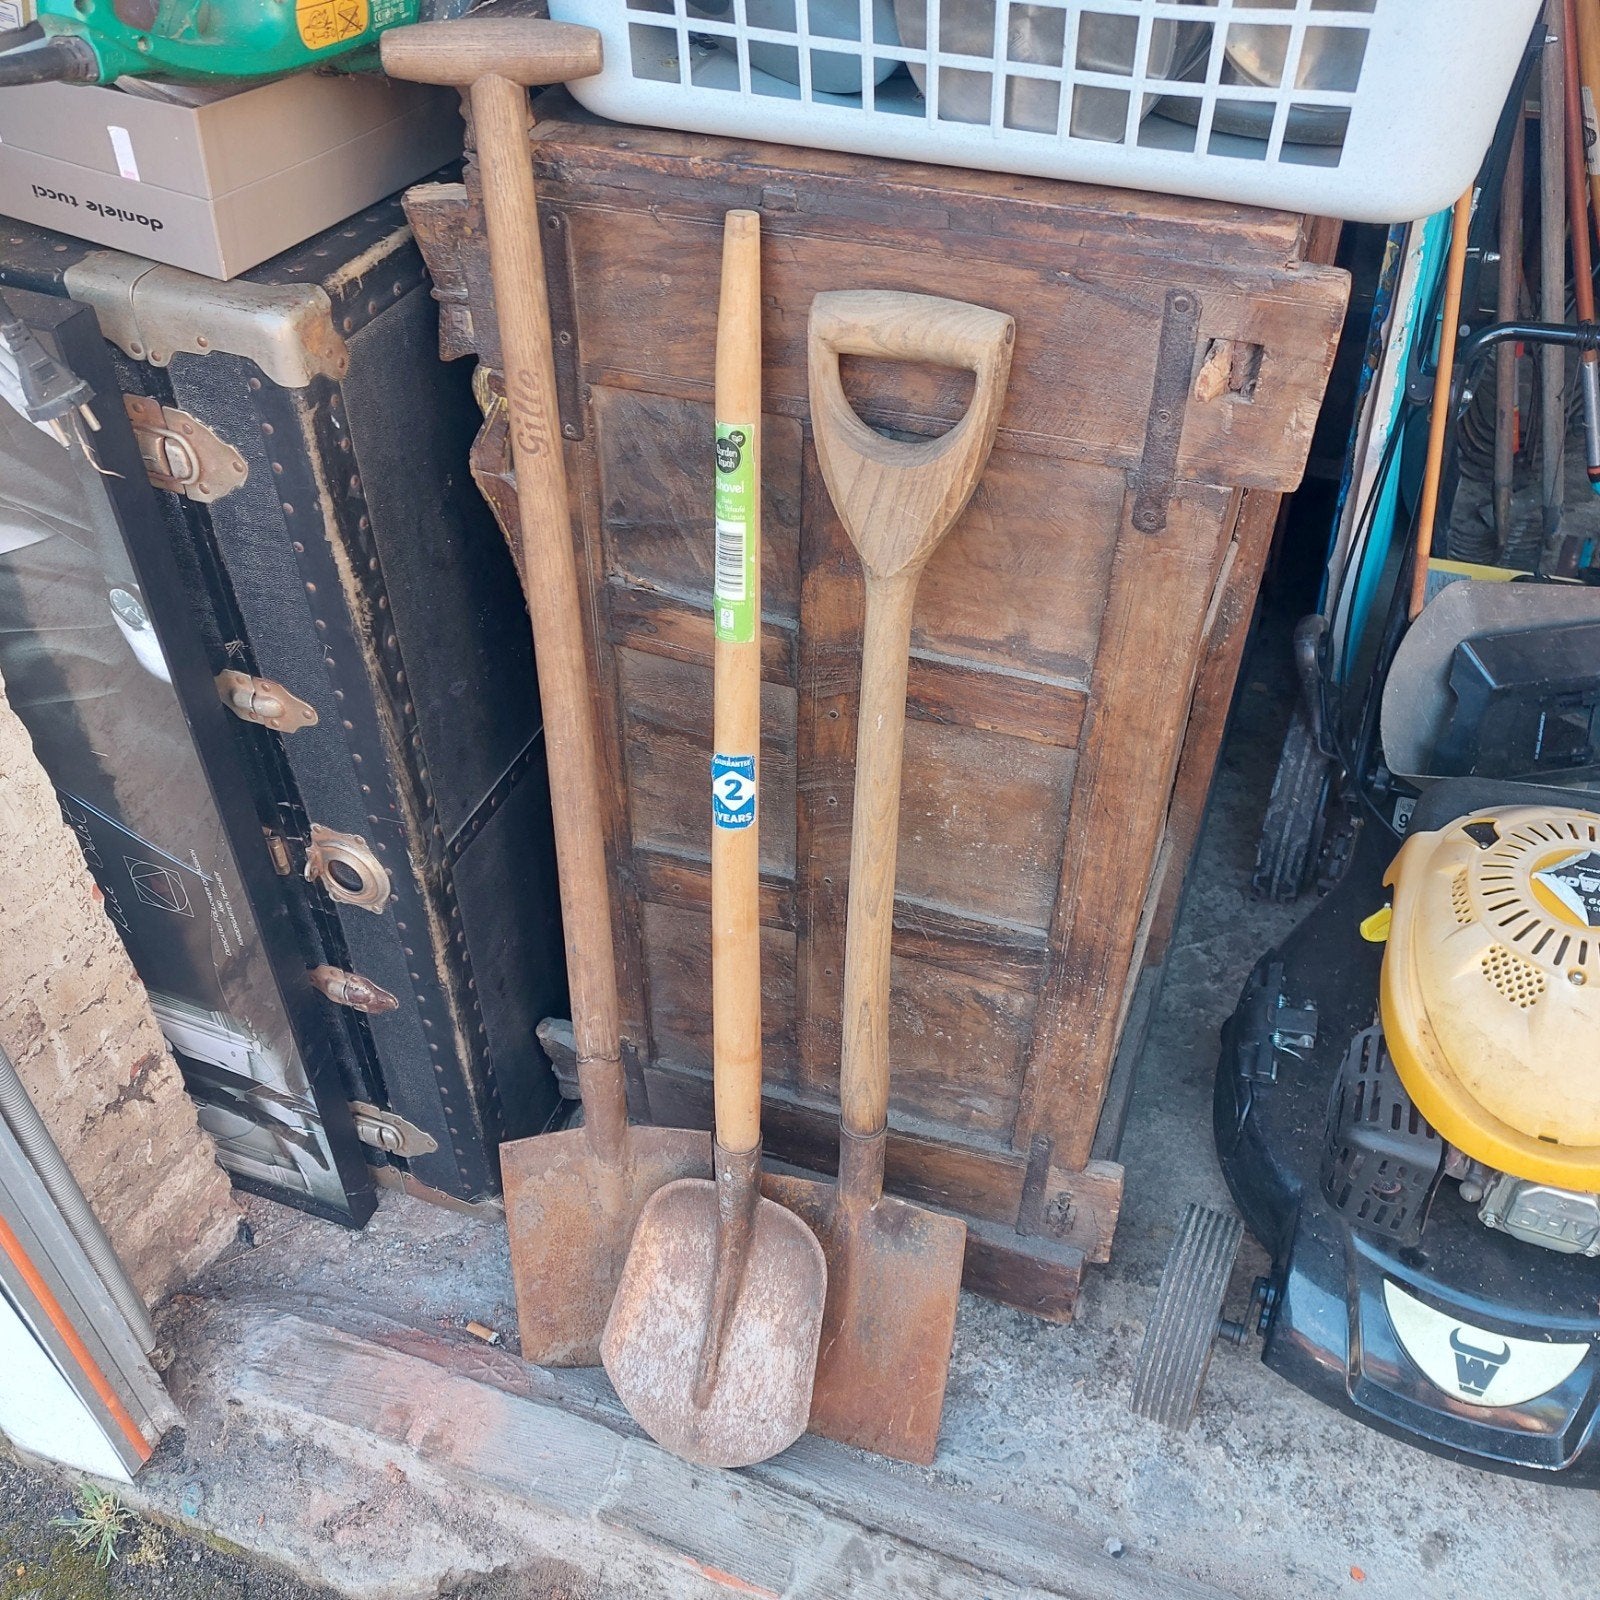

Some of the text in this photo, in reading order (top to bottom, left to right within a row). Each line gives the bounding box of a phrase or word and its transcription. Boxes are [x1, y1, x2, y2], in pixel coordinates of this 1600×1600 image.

[31, 184, 163, 232] daniele tucci
[724, 779, 743, 801] 2
[718, 812, 752, 823] YEARS
[217, 923, 231, 957] DEDICATED
